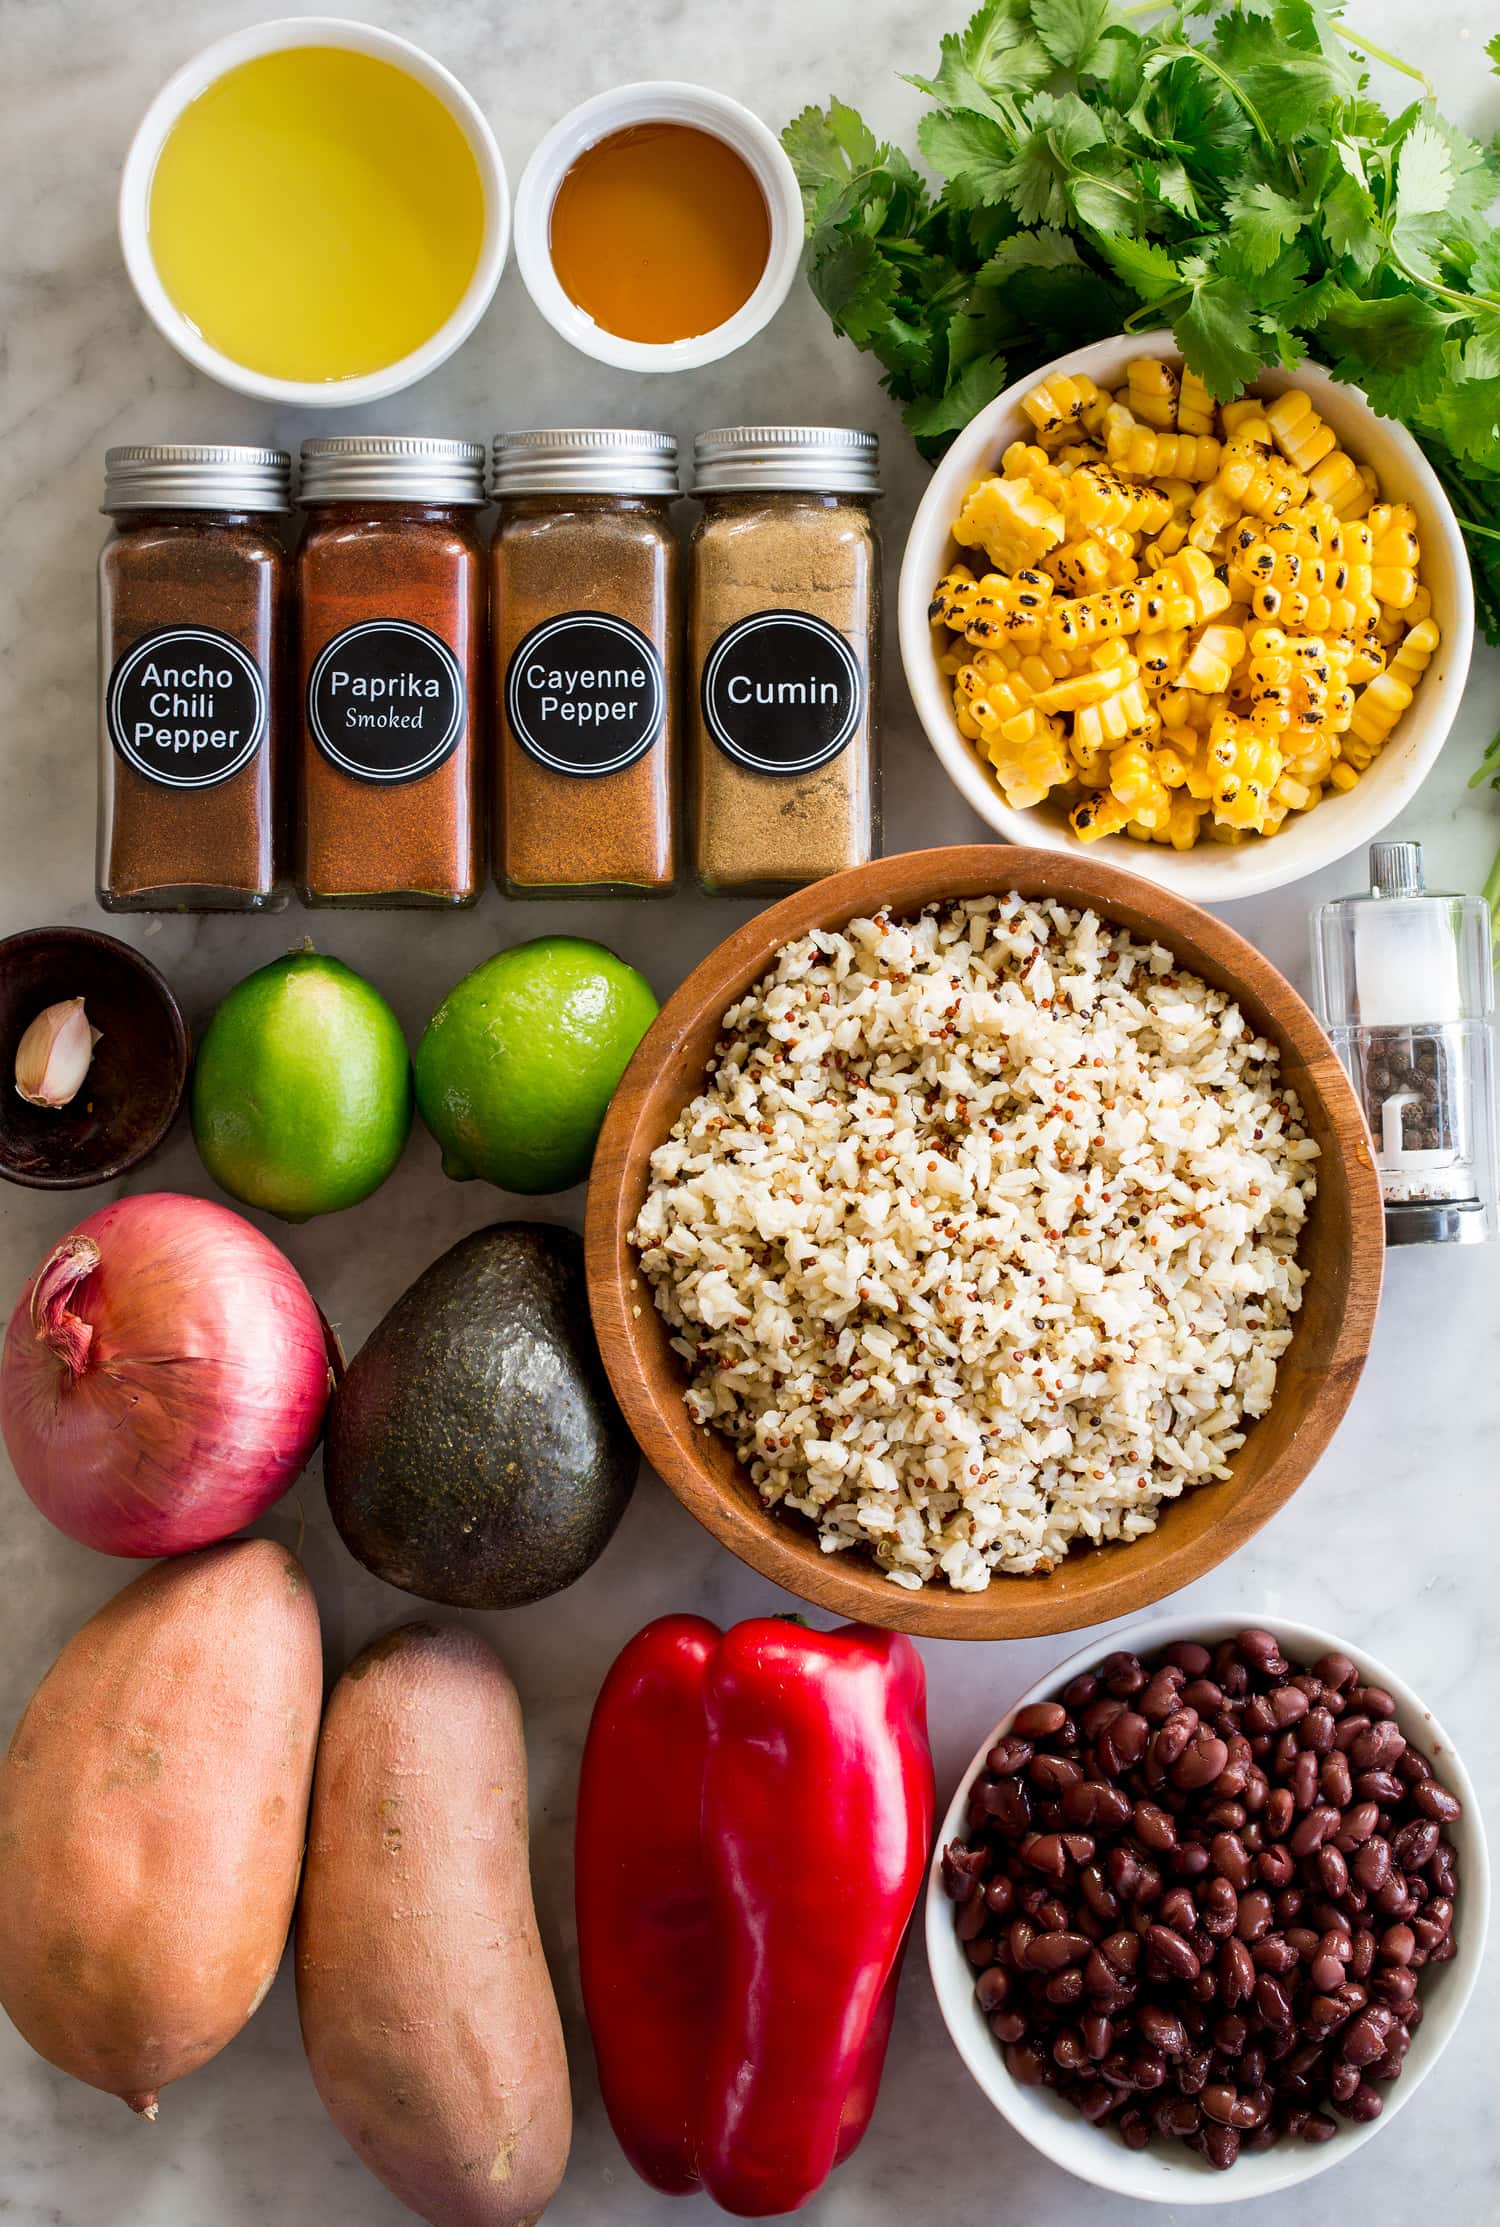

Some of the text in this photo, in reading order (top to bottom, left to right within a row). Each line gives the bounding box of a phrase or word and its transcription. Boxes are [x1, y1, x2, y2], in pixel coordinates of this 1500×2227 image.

[141, 663, 233, 689] Ancho
[331, 671, 440, 702] Paprika
[527, 664, 646, 694] Cayenne
[727, 676, 838, 704] Cumin
[150, 693, 214, 718] Chili
[345, 707, 424, 729] Smoked
[541, 697, 638, 726] Pepper
[135, 722, 239, 753] Pepper
